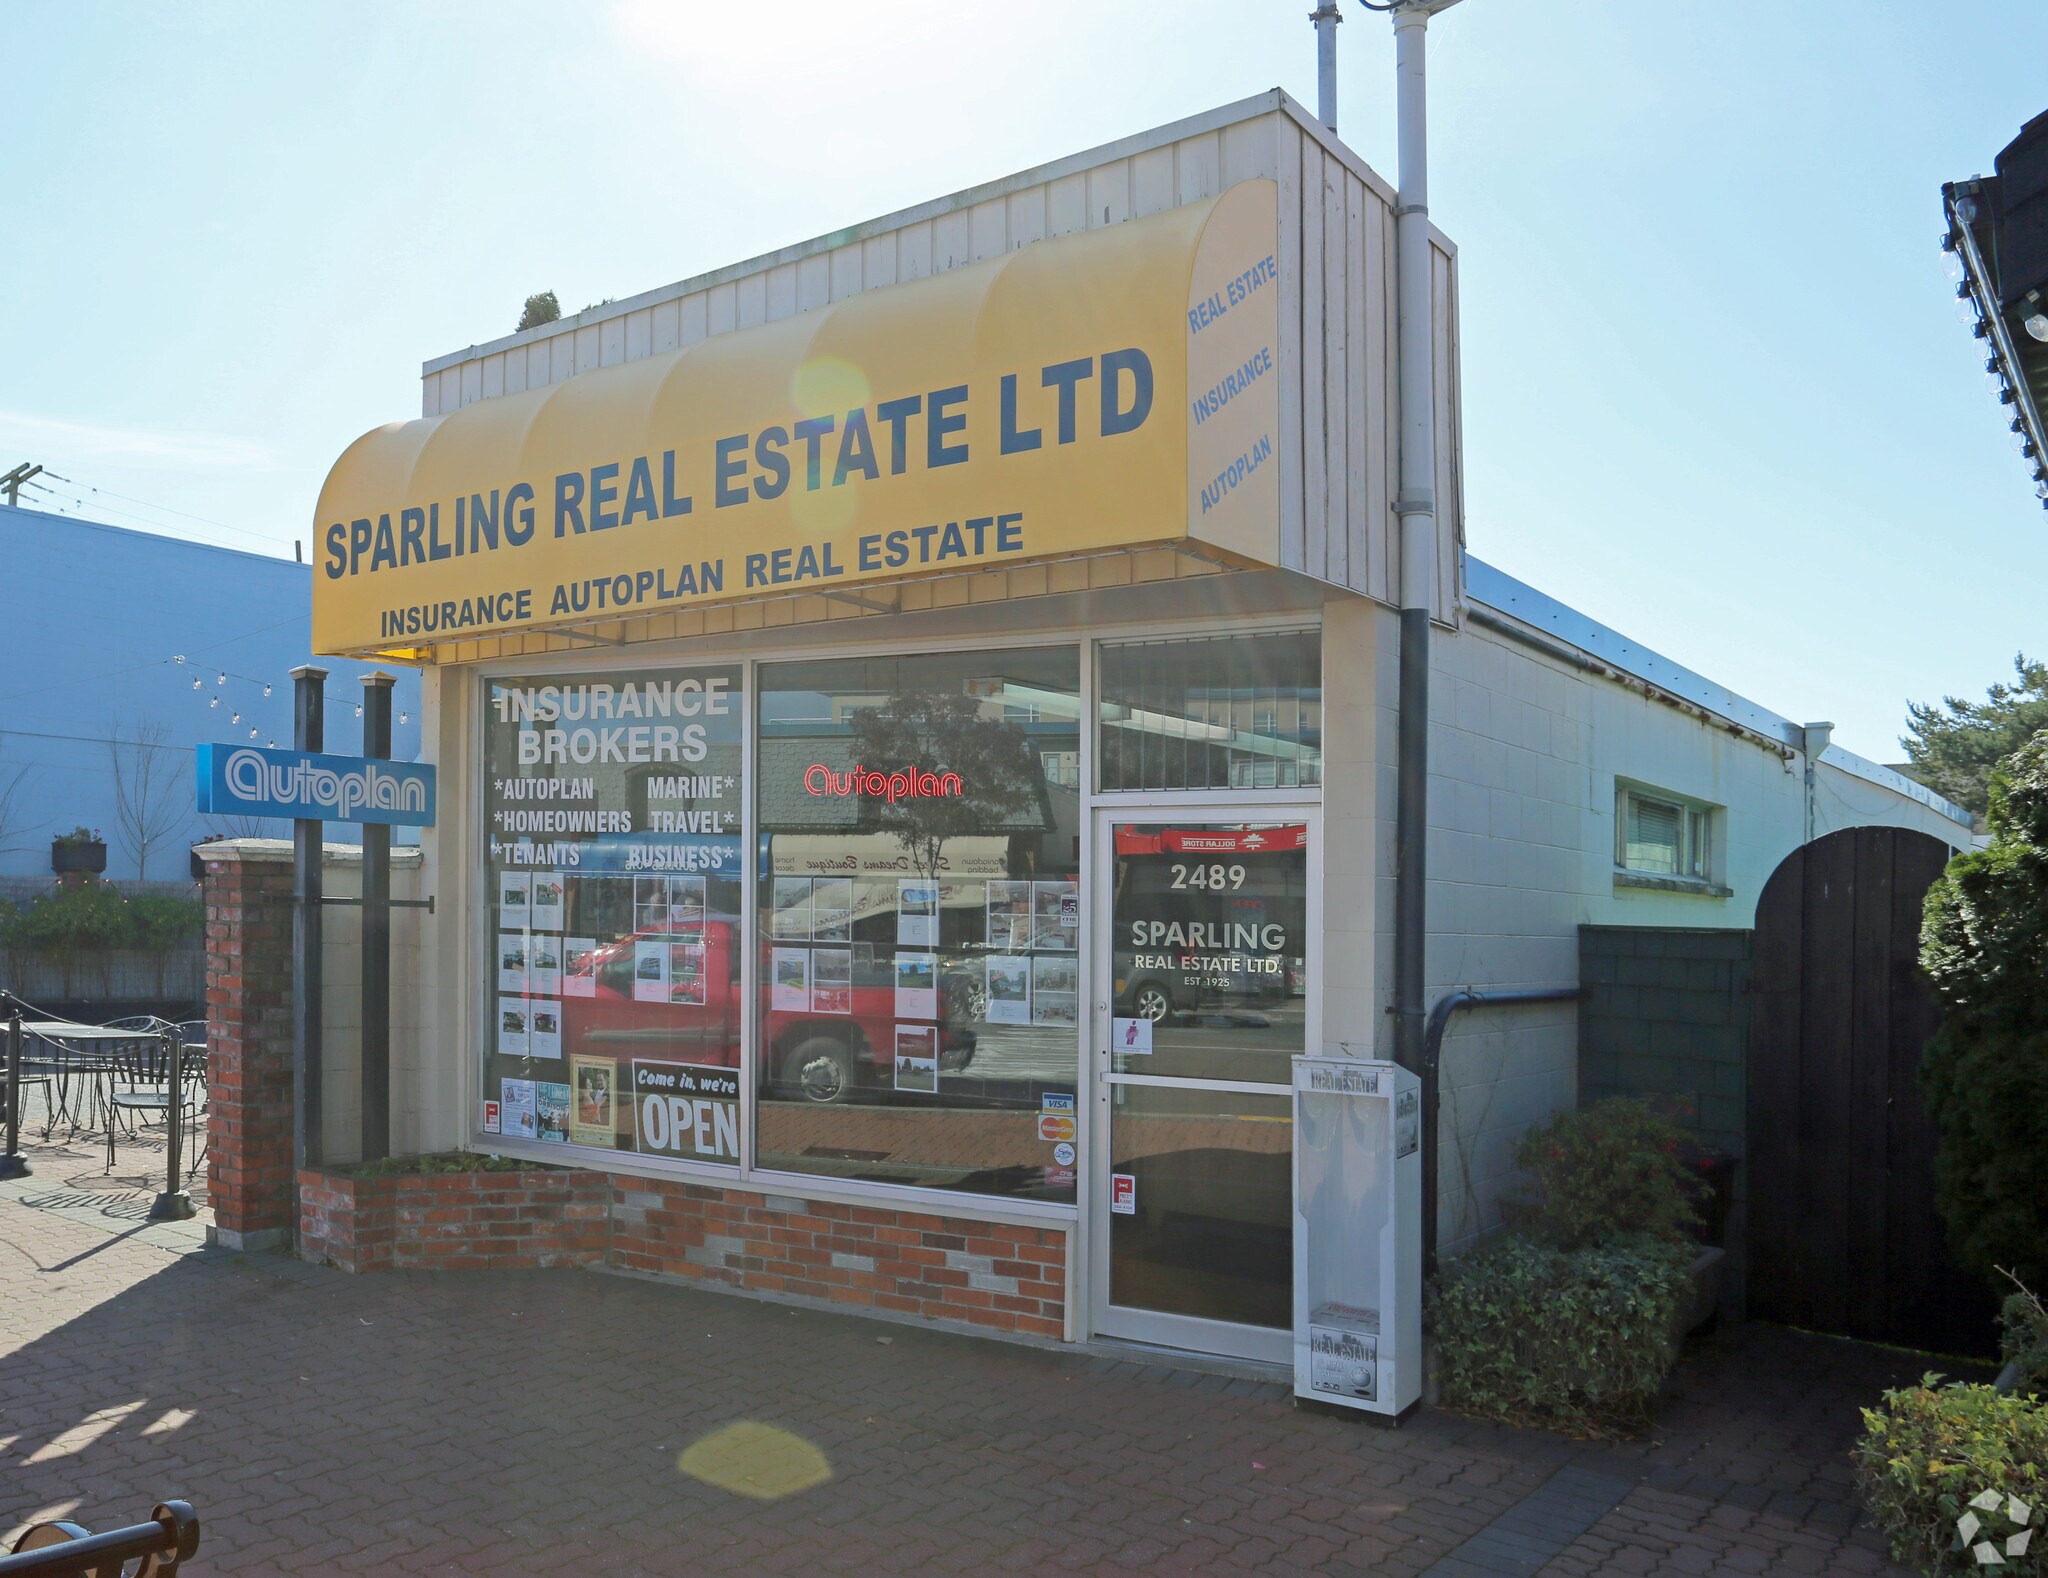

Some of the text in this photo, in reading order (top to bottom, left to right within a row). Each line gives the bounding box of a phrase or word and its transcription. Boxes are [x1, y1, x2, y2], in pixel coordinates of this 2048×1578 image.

[1188, 254, 1277, 334] REAL ESTATE
[1192, 346, 1272, 426] INSURANCE
[325, 347, 1154, 580] SPARLING REAL ESTATE LTD
[1200, 434, 1272, 515] AUTOPLAN
[381, 512, 1024, 638] INSURANCE AUTOPLAN REAL ESTATE
[500, 677, 729, 722] INSURANCE
[518, 724, 708, 765] BROKERS
[1170, 864, 1246, 890] 2489
[1132, 920, 1286, 950] SPARLING
[1135, 954, 1283, 974] REAL ESTATE LTD.
[1206, 976, 1230, 987] 1925
[638, 1069, 736, 1094] Come in, we're
[1313, 1074, 1375, 1093] REAL ESTATE
[1048, 1100, 1067, 1109] VISA
[642, 1093, 739, 1158] OPEN
[1313, 1337, 1375, 1362] REAL ESTATE
